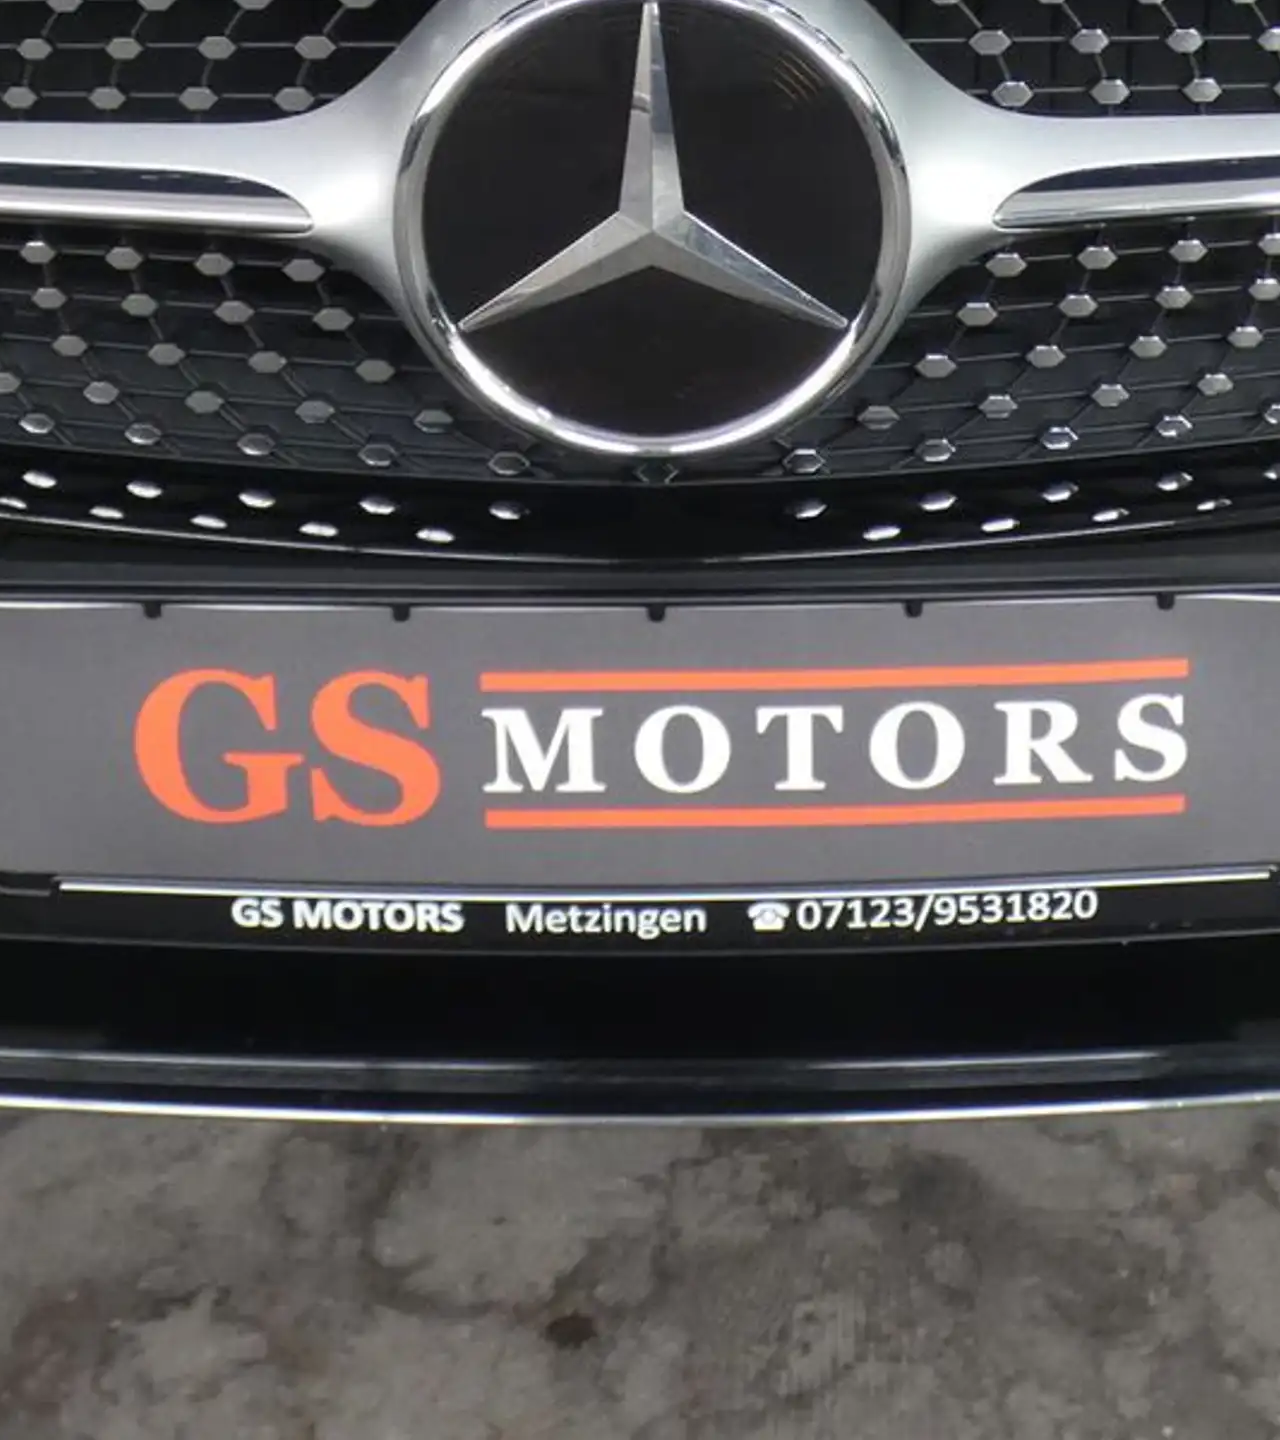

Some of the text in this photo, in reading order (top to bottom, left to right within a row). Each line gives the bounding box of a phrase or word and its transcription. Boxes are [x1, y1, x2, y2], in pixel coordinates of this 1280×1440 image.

[134, 669, 1190, 827] GS MOTORS
[231, 889, 1098, 940] GS MOTORS Metzingen 07123/9531820
